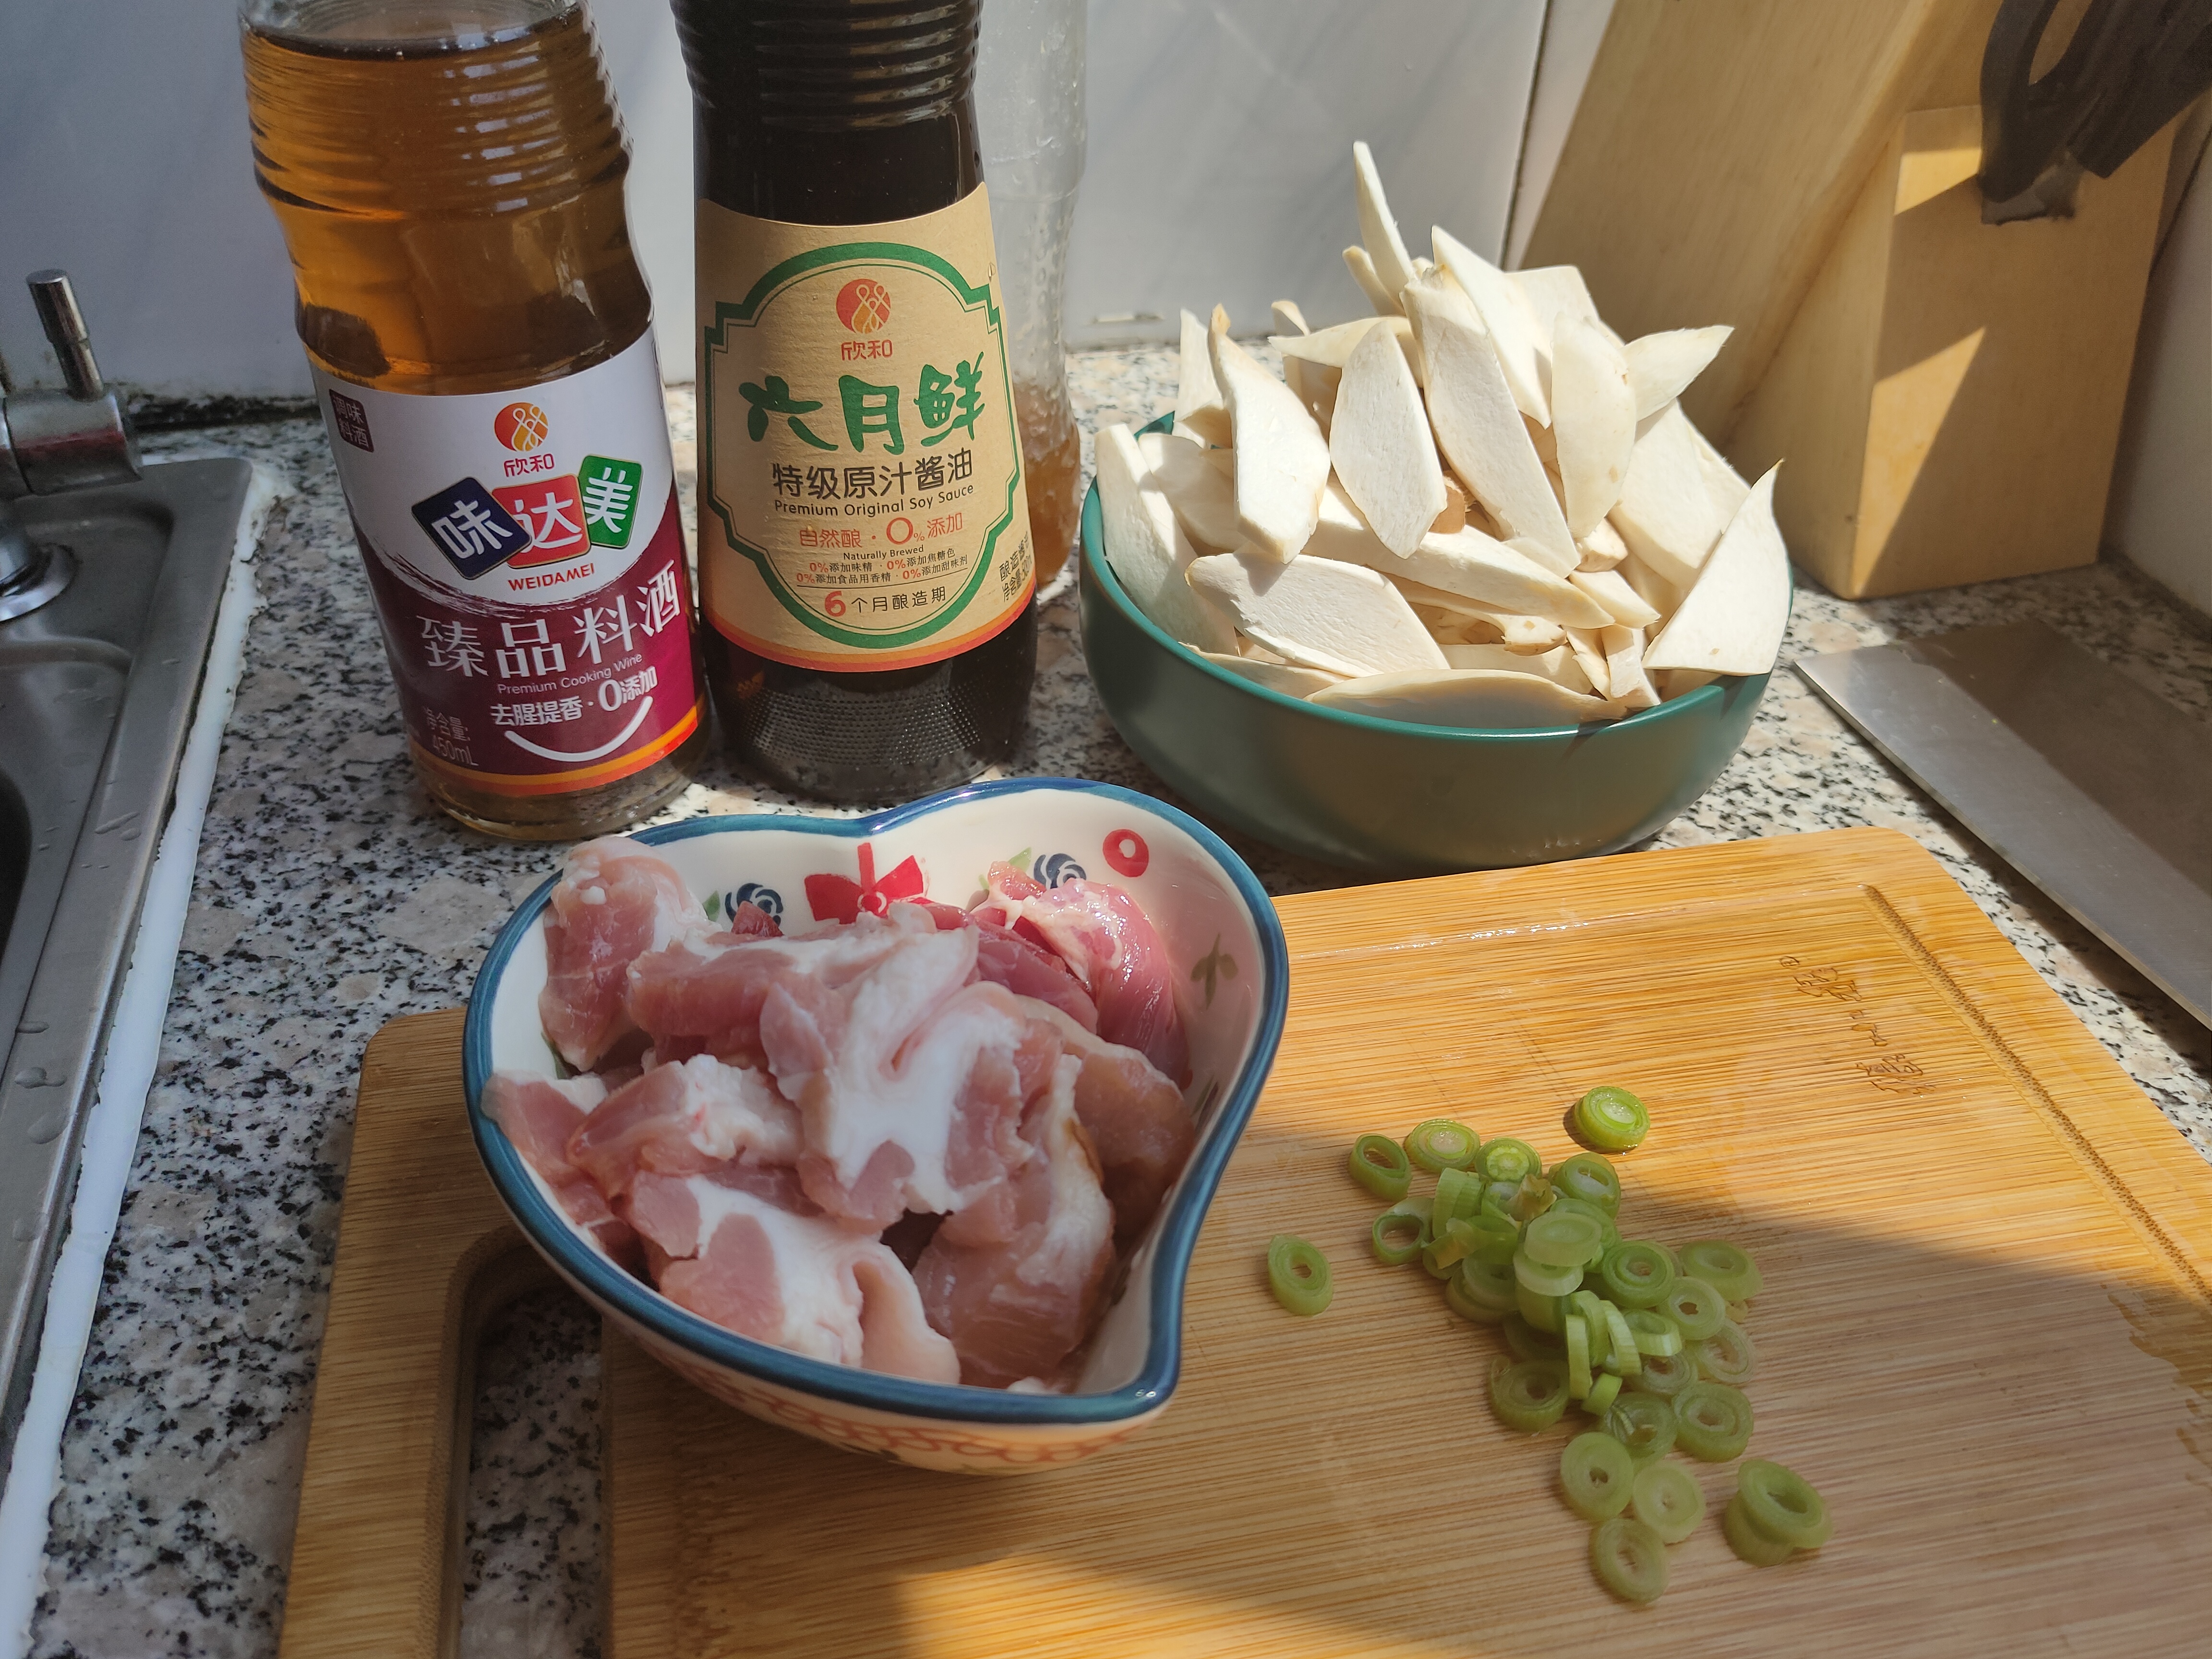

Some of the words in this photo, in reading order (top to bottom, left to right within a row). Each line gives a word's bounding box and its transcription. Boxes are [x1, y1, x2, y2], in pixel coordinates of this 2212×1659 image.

[841, 339, 892, 361] 欣和
[739, 352, 985, 455] 六月鲜
[504, 454, 555, 477] 欣和
[772, 447, 973, 500] 特级原汁酱油
[432, 467, 633, 559] 味达美
[775, 500, 838, 516] Premium
[844, 499, 904, 517] Original
[909, 495, 933, 510] Soy
[938, 484, 974, 504] Sauce
[843, 551, 887, 561] Naturally
[890, 544, 924, 557] Brewed
[508, 563, 595, 591] WEIDAMEI
[417, 560, 681, 678] 臻品料酒
[497, 681, 557, 694] Premium
[560, 667, 612, 688] Cooking
[613, 653, 643, 672] Wine
[433, 735, 479, 766] 450mL
